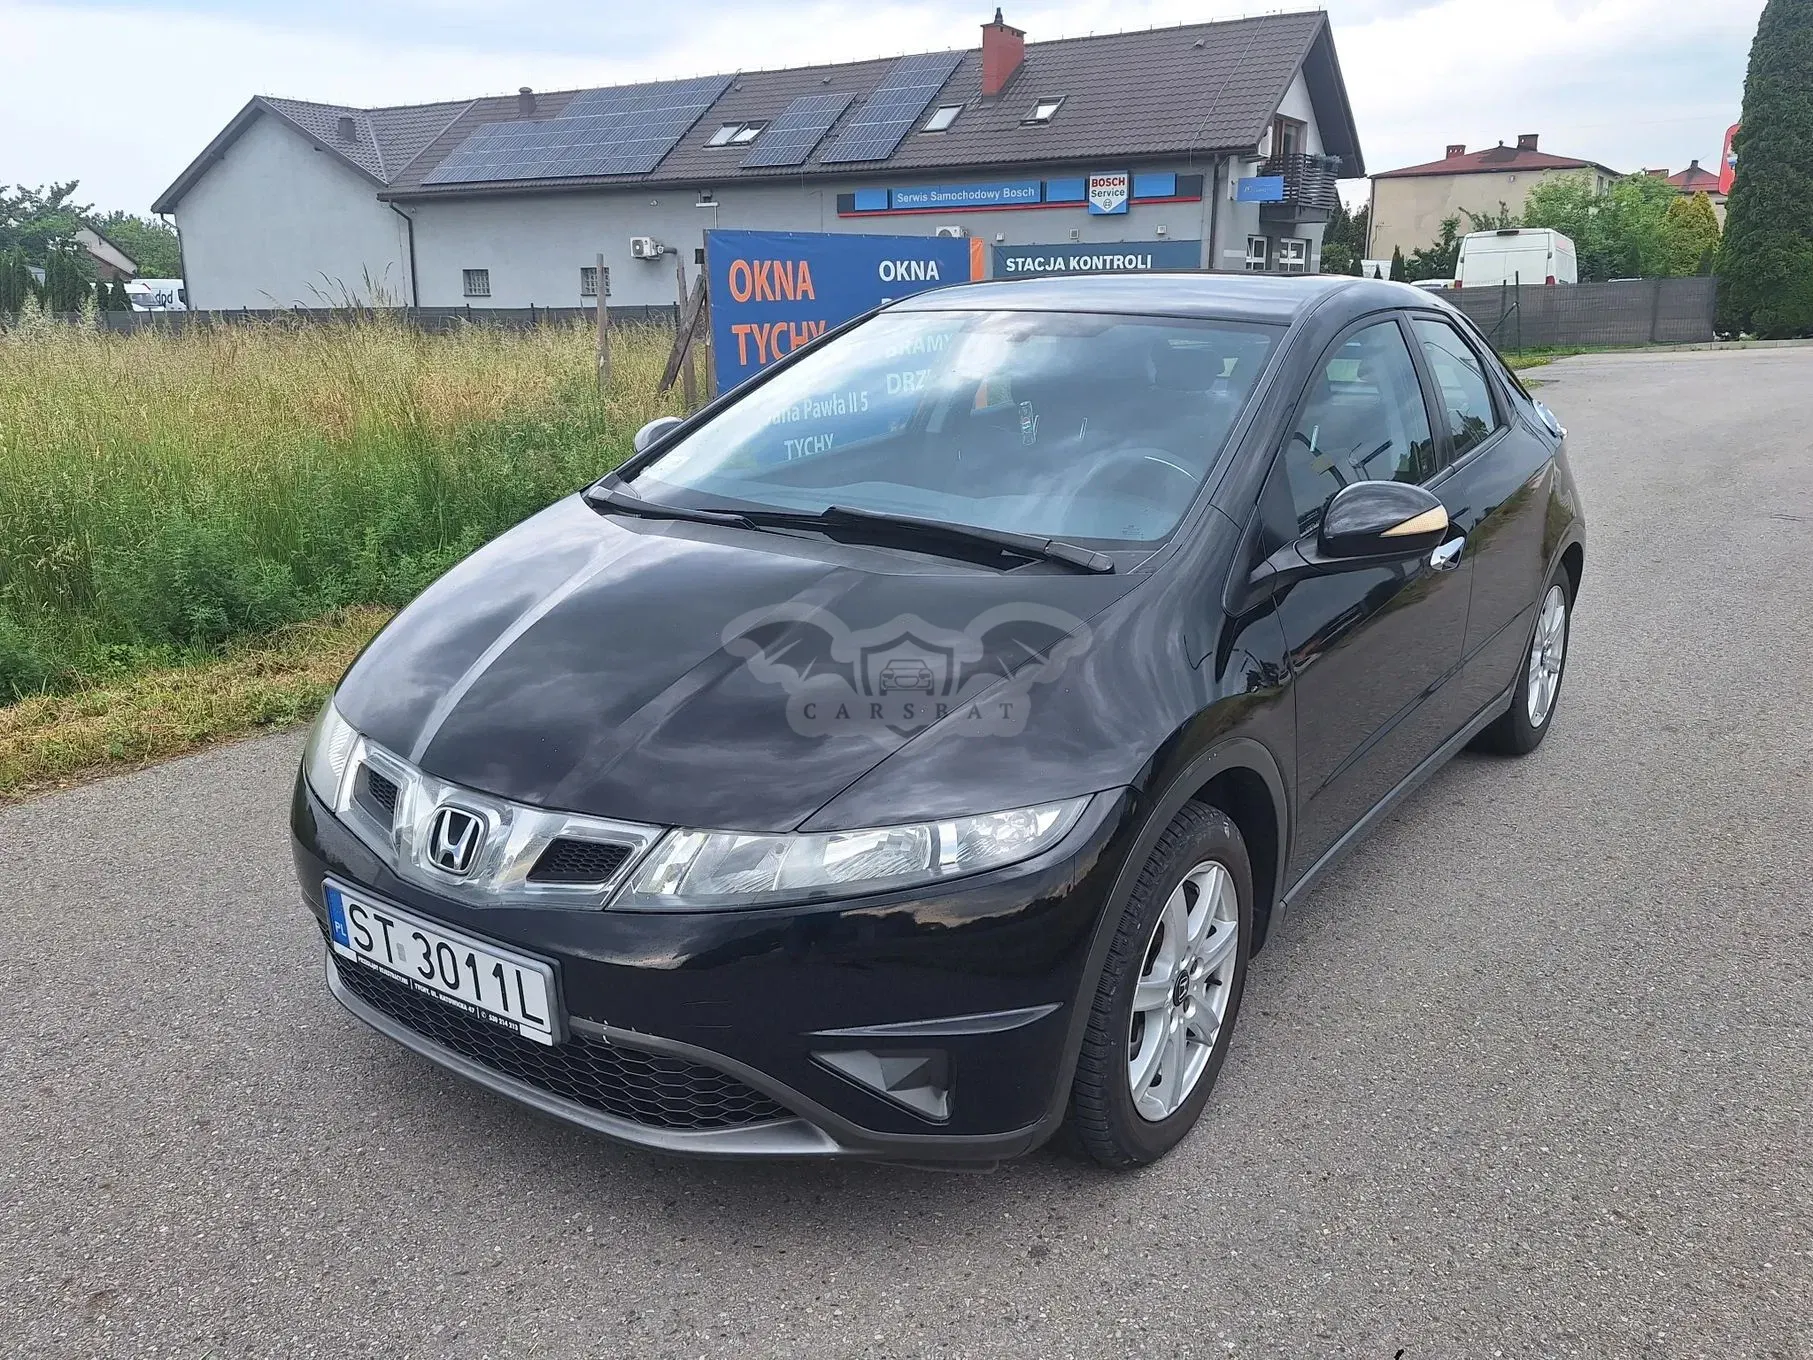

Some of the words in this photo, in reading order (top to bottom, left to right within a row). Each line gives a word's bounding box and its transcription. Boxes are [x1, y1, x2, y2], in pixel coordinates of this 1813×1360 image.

[1091, 177, 1126, 187] BOSCH
[897, 192, 928, 203] Serwis
[930, 188, 1000, 201] Samochodowy
[1003, 186, 1035, 198] Bosch
[1091, 188, 1126, 198] Service
[878, 260, 940, 282] OKNA
[1006, 257, 1066, 272] STACJA
[1070, 254, 1152, 270] KONTROLI
[728, 259, 816, 303] OKNA
[155, 289, 173, 308] dpd
[803, 392, 846, 420] Pawła
[861, 390, 869, 412] 5
[783, 432, 834, 461] TYCHY
[334, 920, 347, 937] PL
[348, 903, 395, 965] ST
[411, 931, 545, 1026] 3011L
